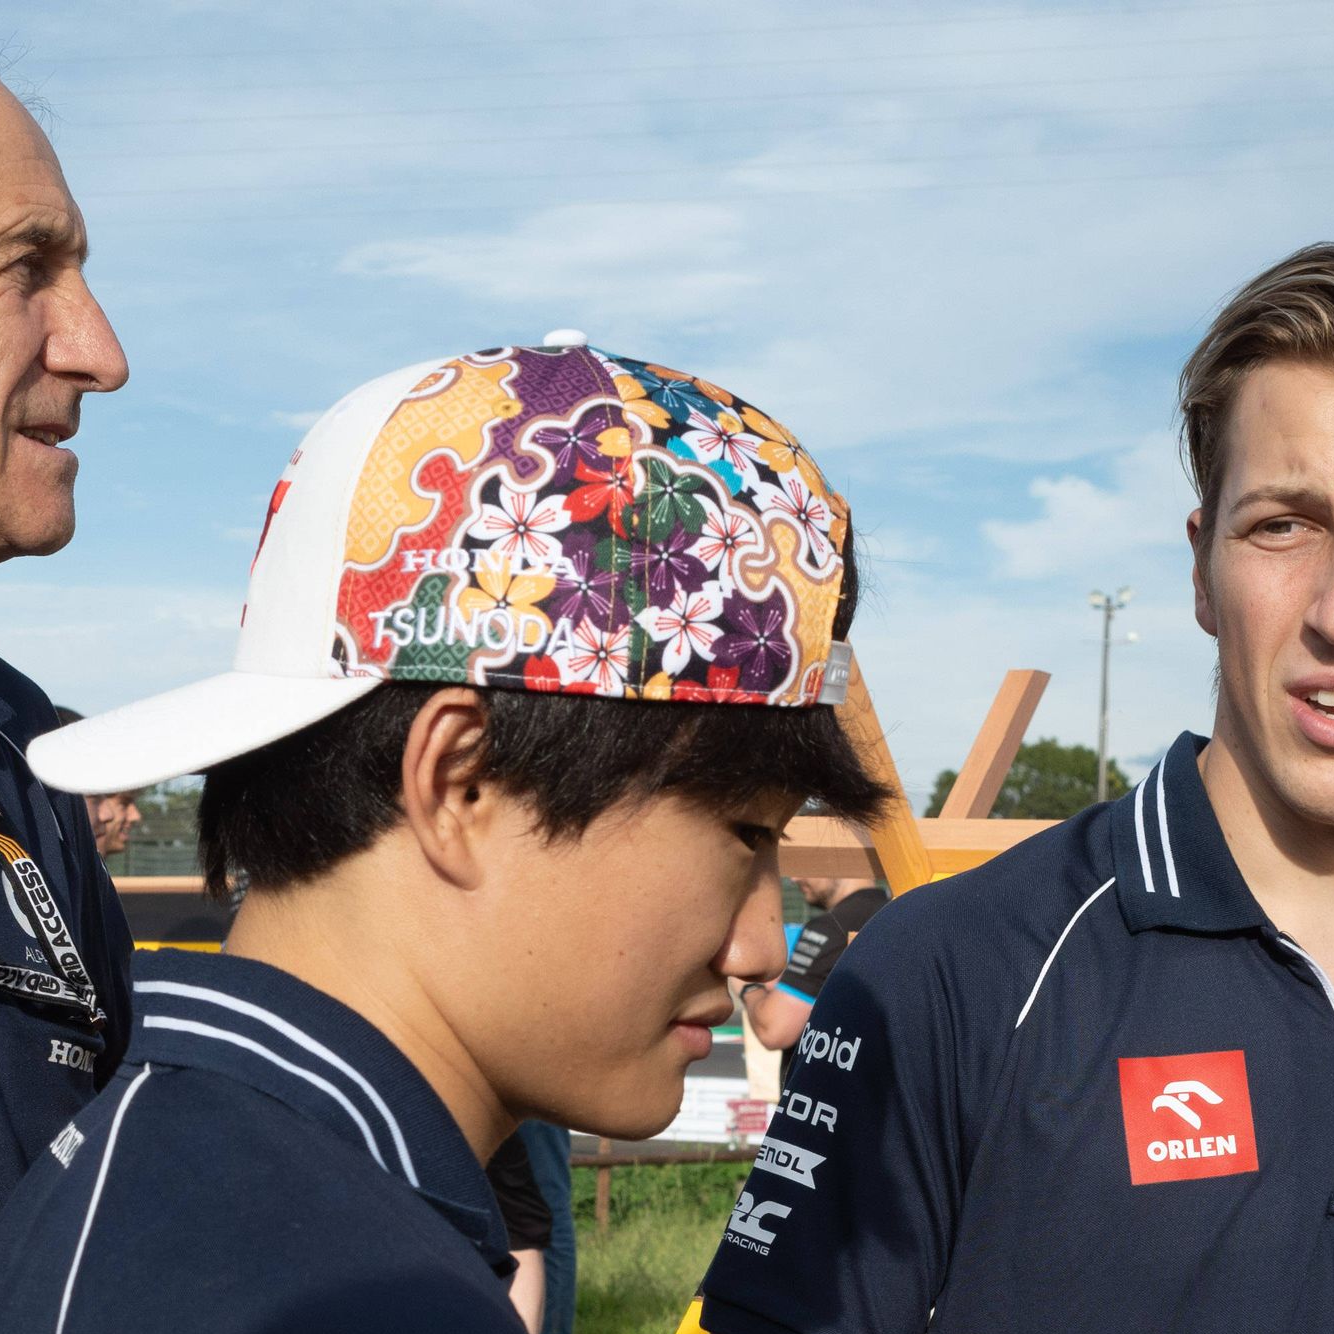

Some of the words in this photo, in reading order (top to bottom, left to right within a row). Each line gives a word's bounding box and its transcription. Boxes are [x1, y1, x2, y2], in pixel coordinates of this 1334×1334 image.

[400, 549, 579, 579] HONDA
[368, 607, 578, 655] TSUNODA
[16, 861, 68, 947] ACCESS
[47, 1040, 97, 1073] HON
[1147, 1135, 1237, 1162] ORLEN
